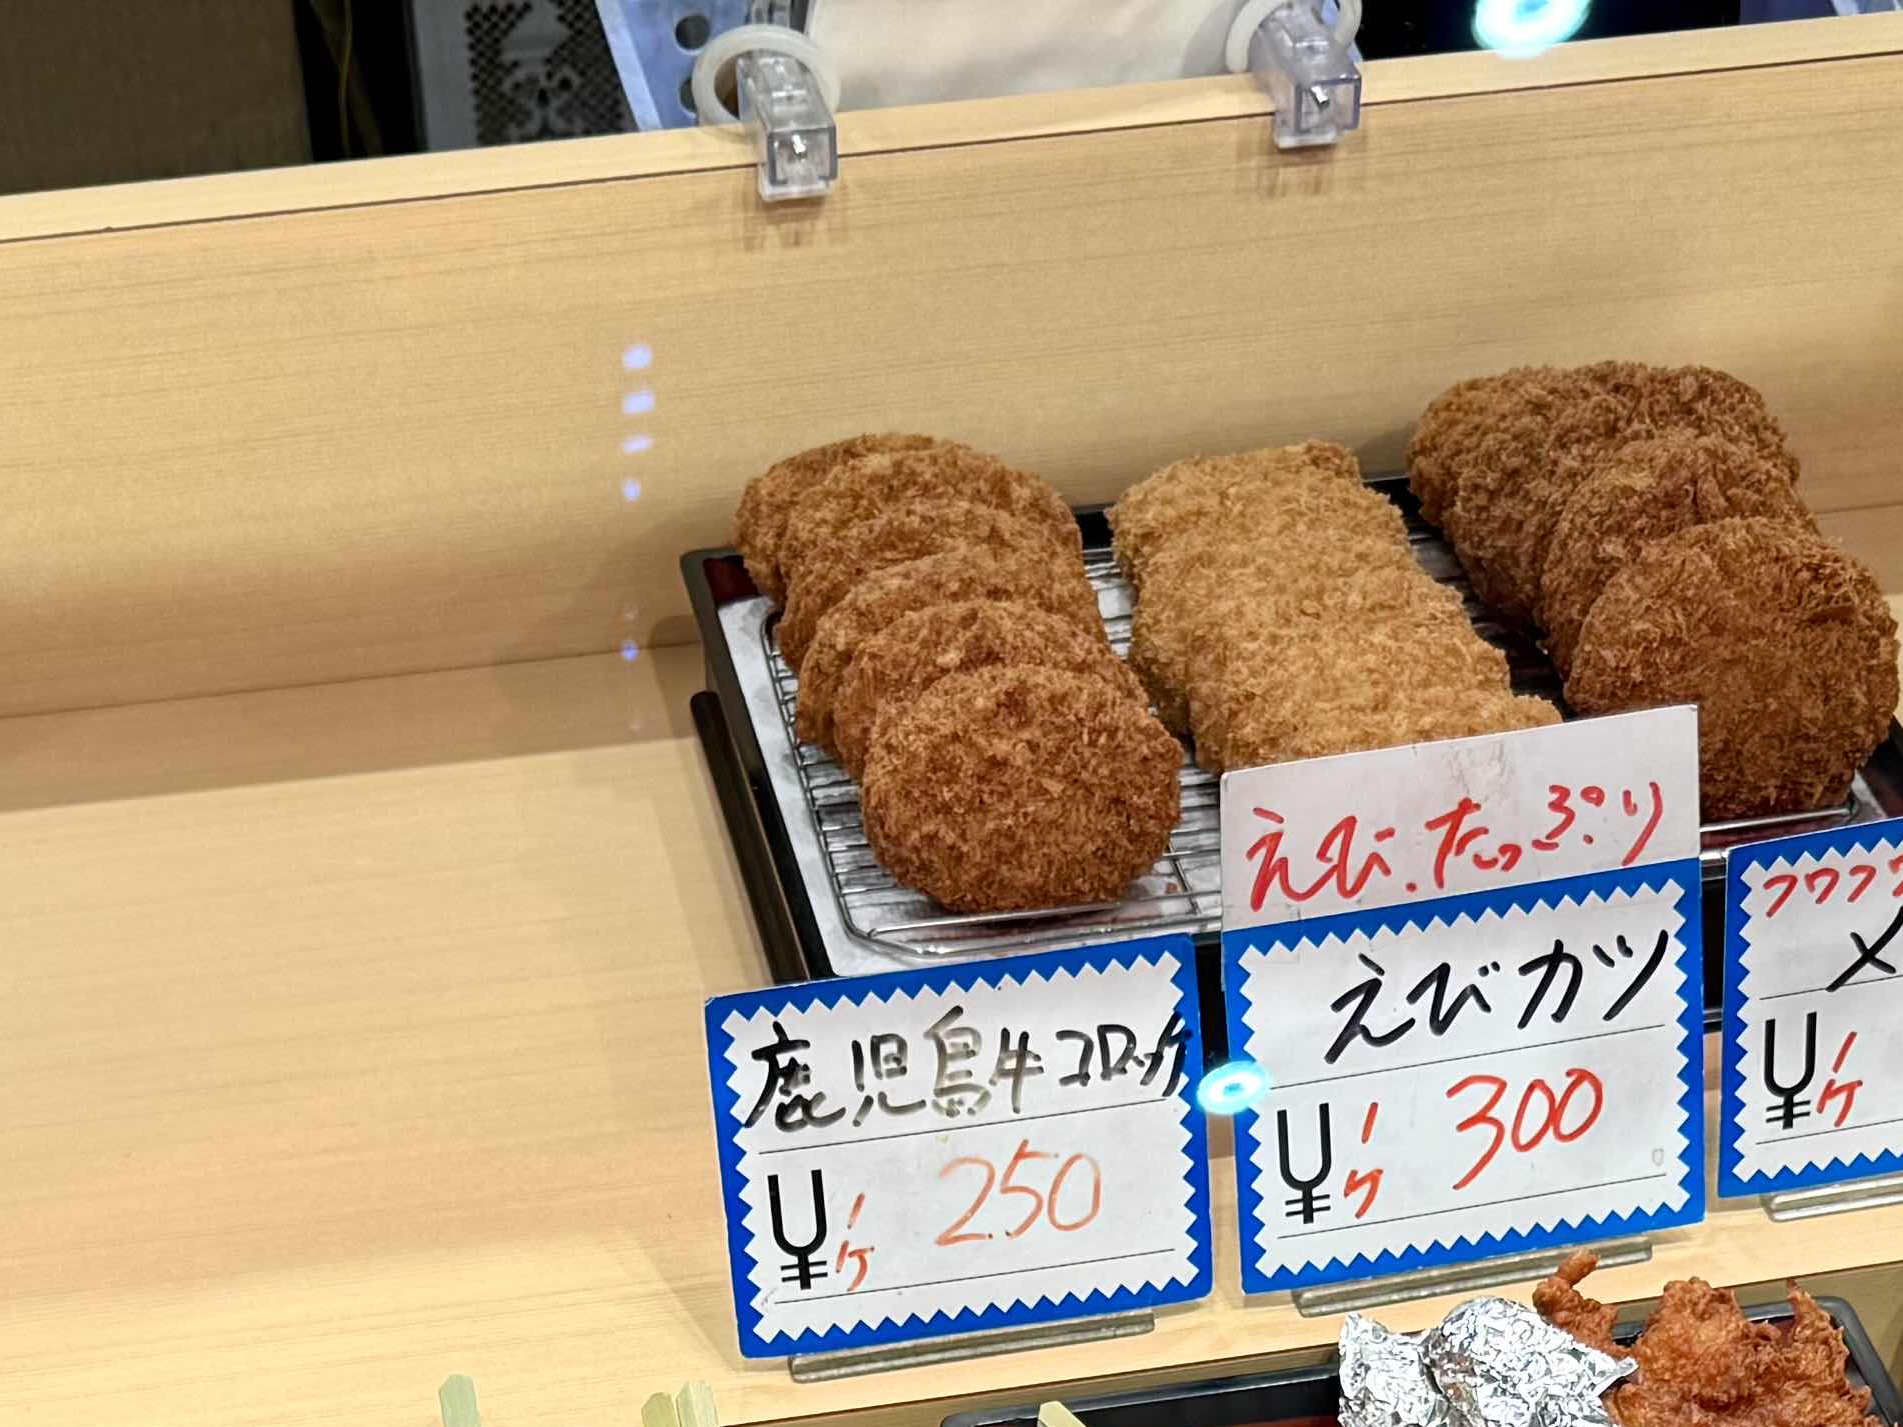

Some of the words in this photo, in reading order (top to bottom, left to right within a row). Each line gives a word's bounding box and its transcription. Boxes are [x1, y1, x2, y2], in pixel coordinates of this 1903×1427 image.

[1325, 930, 1669, 1064] えびカツ
[1447, 1068, 1603, 1190] 300
[935, 1140, 1101, 1248] 250
